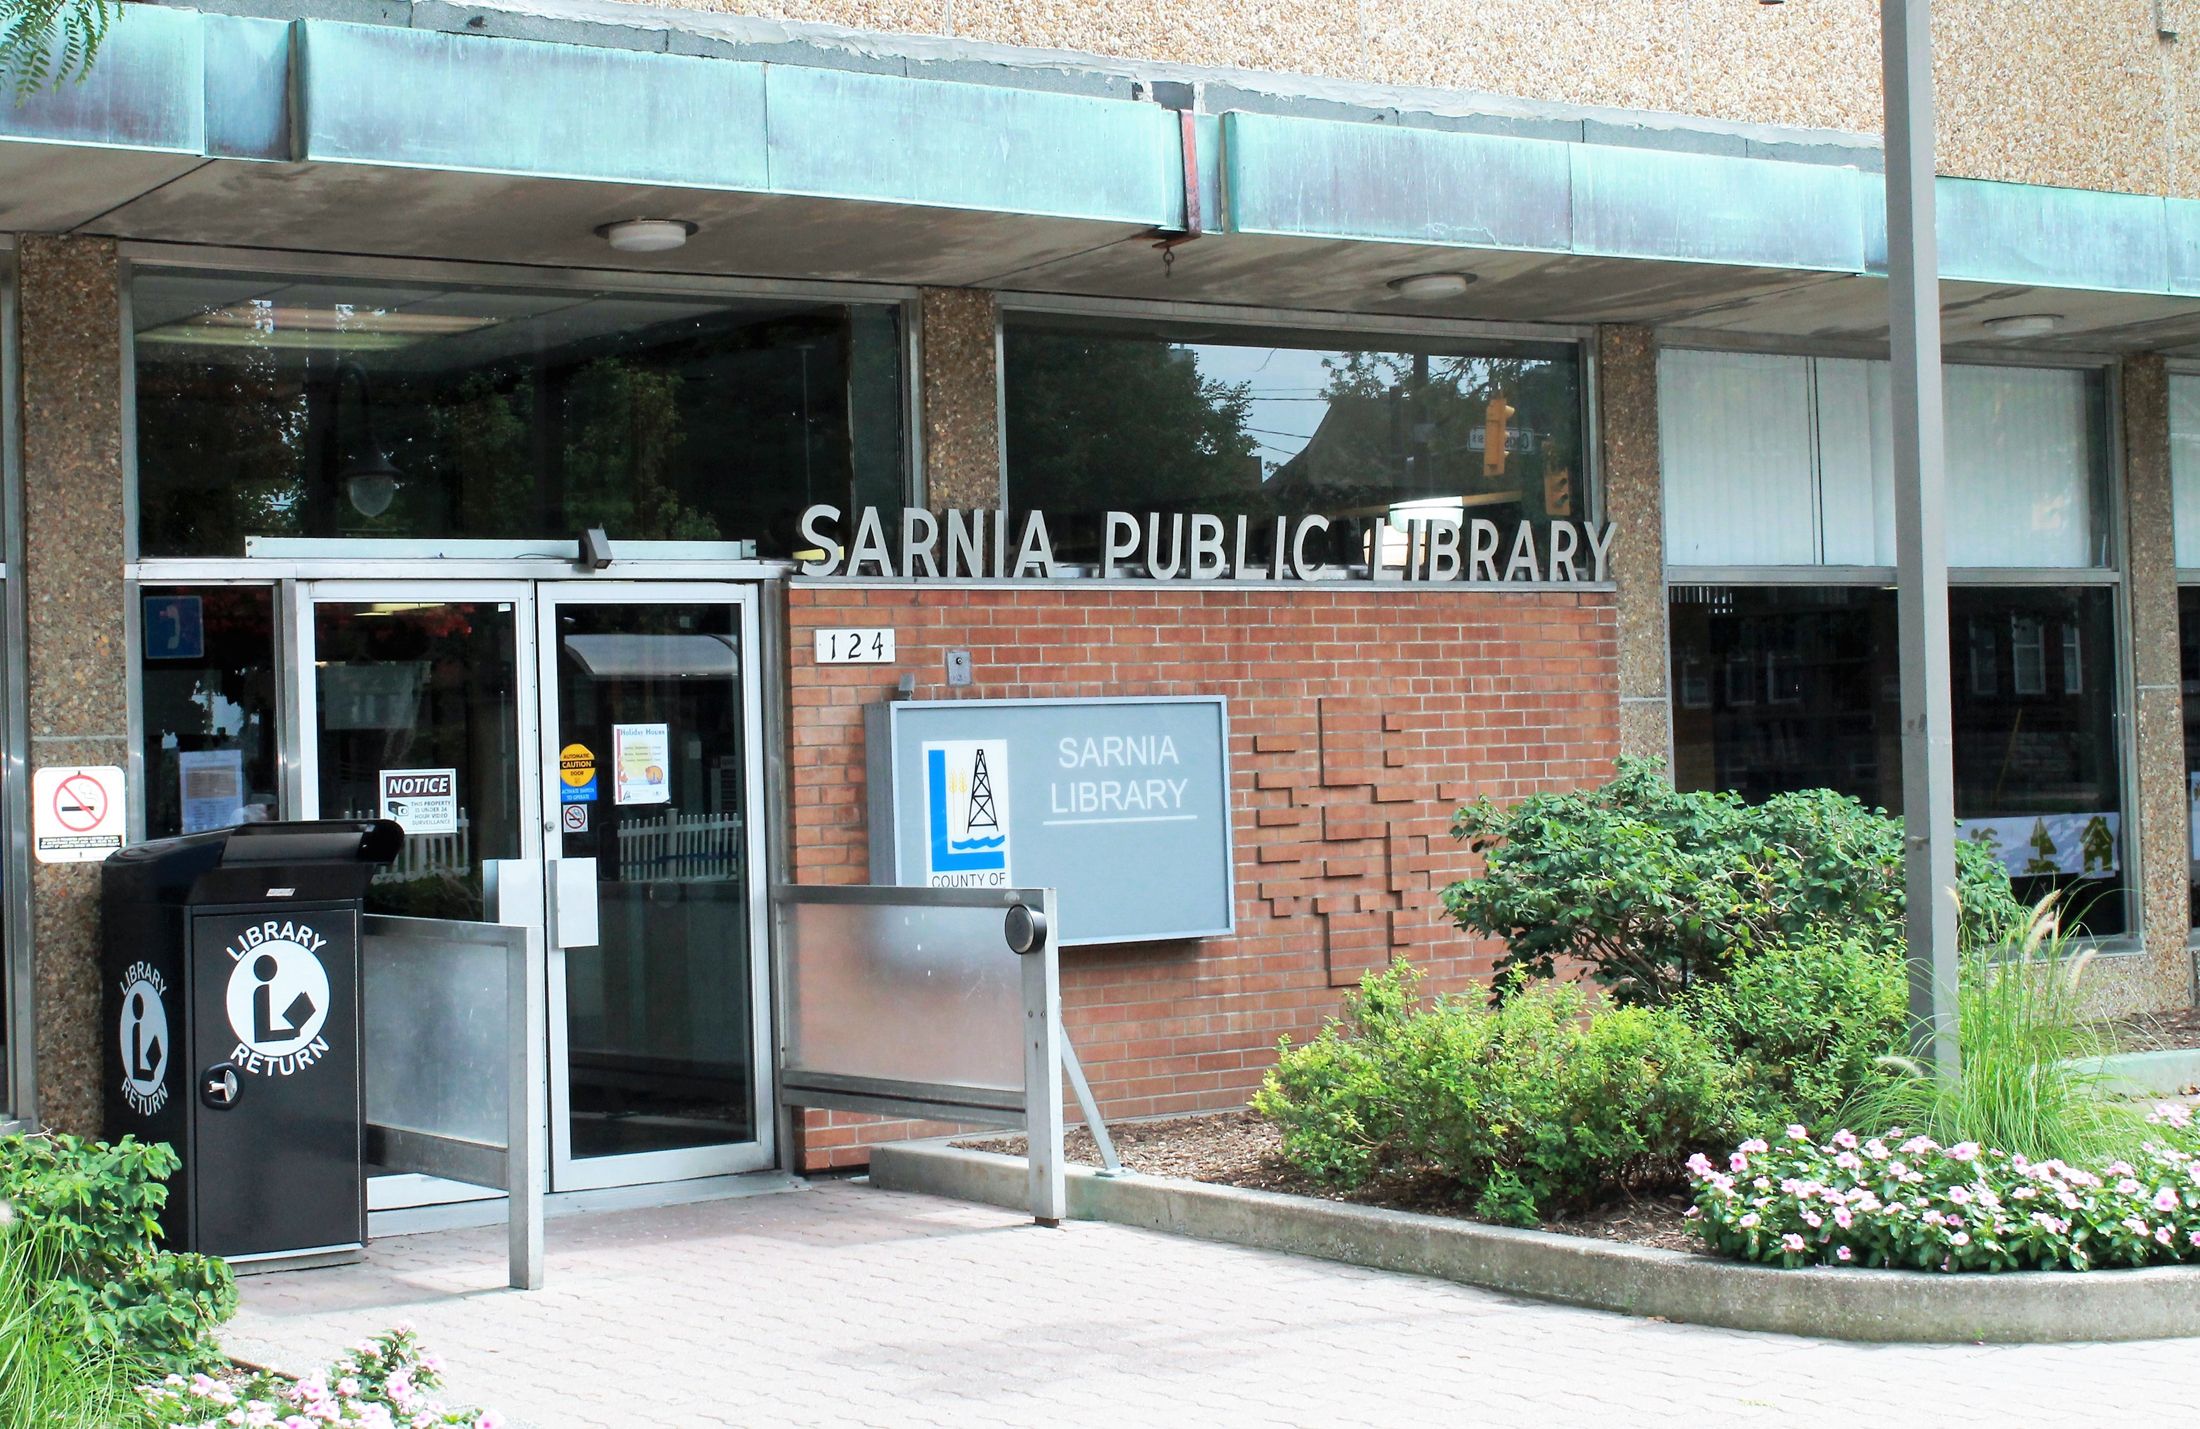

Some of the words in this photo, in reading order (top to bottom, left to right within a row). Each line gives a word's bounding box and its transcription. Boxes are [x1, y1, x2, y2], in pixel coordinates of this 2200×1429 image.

[801, 503, 1058, 578] SARNIA
[1104, 510, 1330, 581] PUBLIC
[1372, 517, 1618, 582] LIBRARY
[830, 631, 884, 661] 124
[562, 760, 592, 769] CAUTION
[1057, 734, 1180, 769] SARNIA
[389, 778, 448, 794] NOTICE
[1050, 777, 1189, 814] LIBRARY
[931, 873, 985, 888] COUNTY
[989, 872, 1006, 886] OF
[226, 920, 328, 962] LIBRARY
[119, 960, 168, 997] LIBRARY
[230, 1035, 330, 1077] RETURN
[121, 1076, 169, 1117] RETURN
